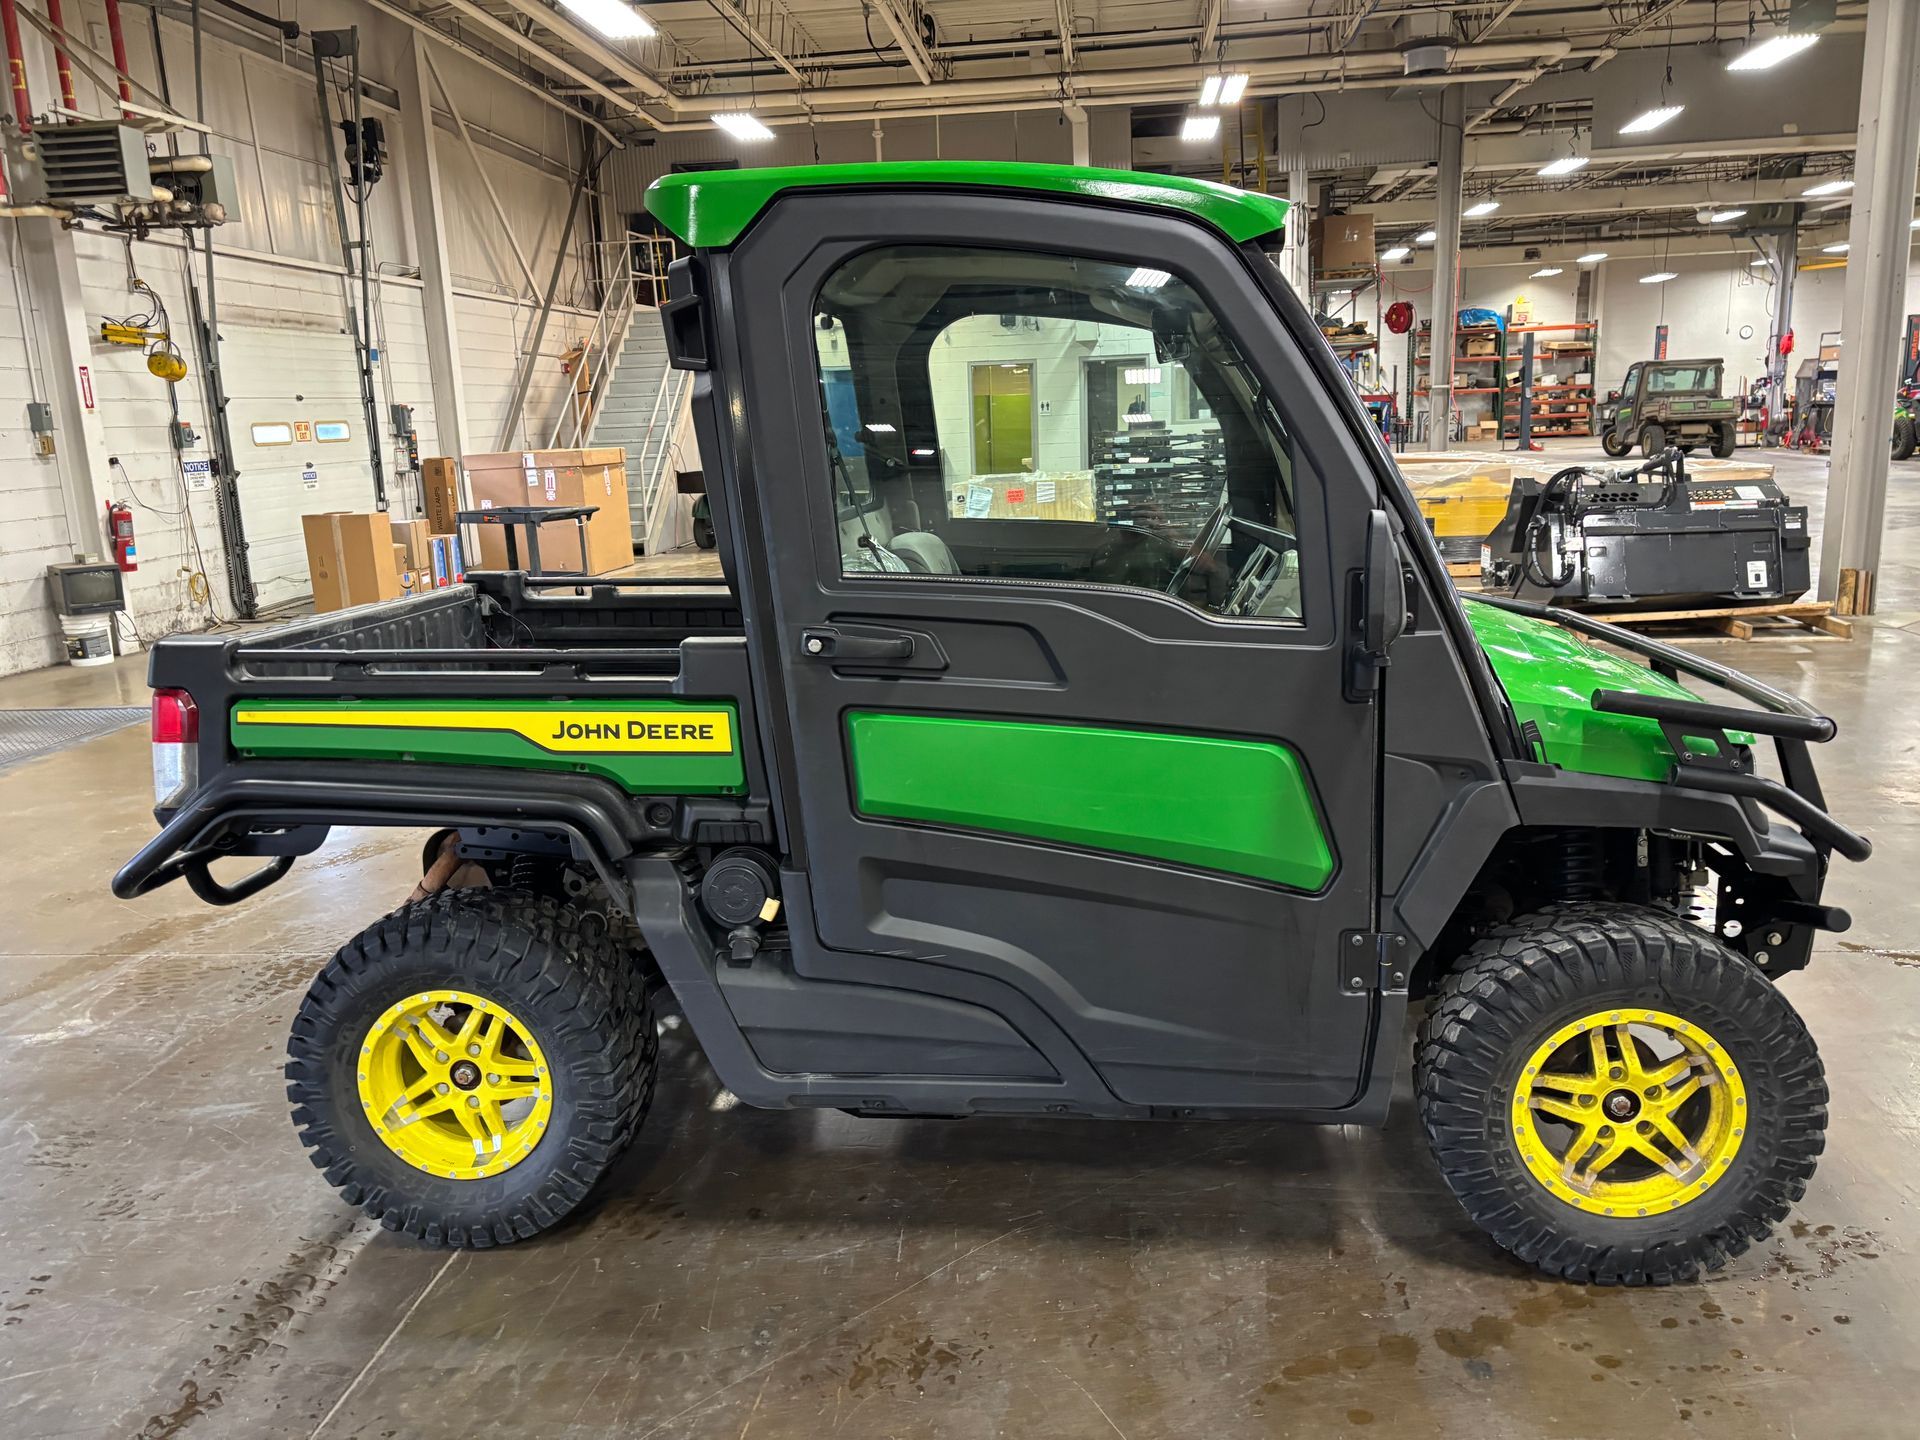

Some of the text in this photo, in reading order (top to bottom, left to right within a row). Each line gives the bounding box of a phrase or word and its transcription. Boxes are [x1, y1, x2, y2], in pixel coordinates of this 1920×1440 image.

[184, 462, 208, 471] NOTICE
[433, 486, 442, 508] LAMPS
[435, 508, 443, 530] WASTE
[552, 720, 714, 740] JOHN DEERE
